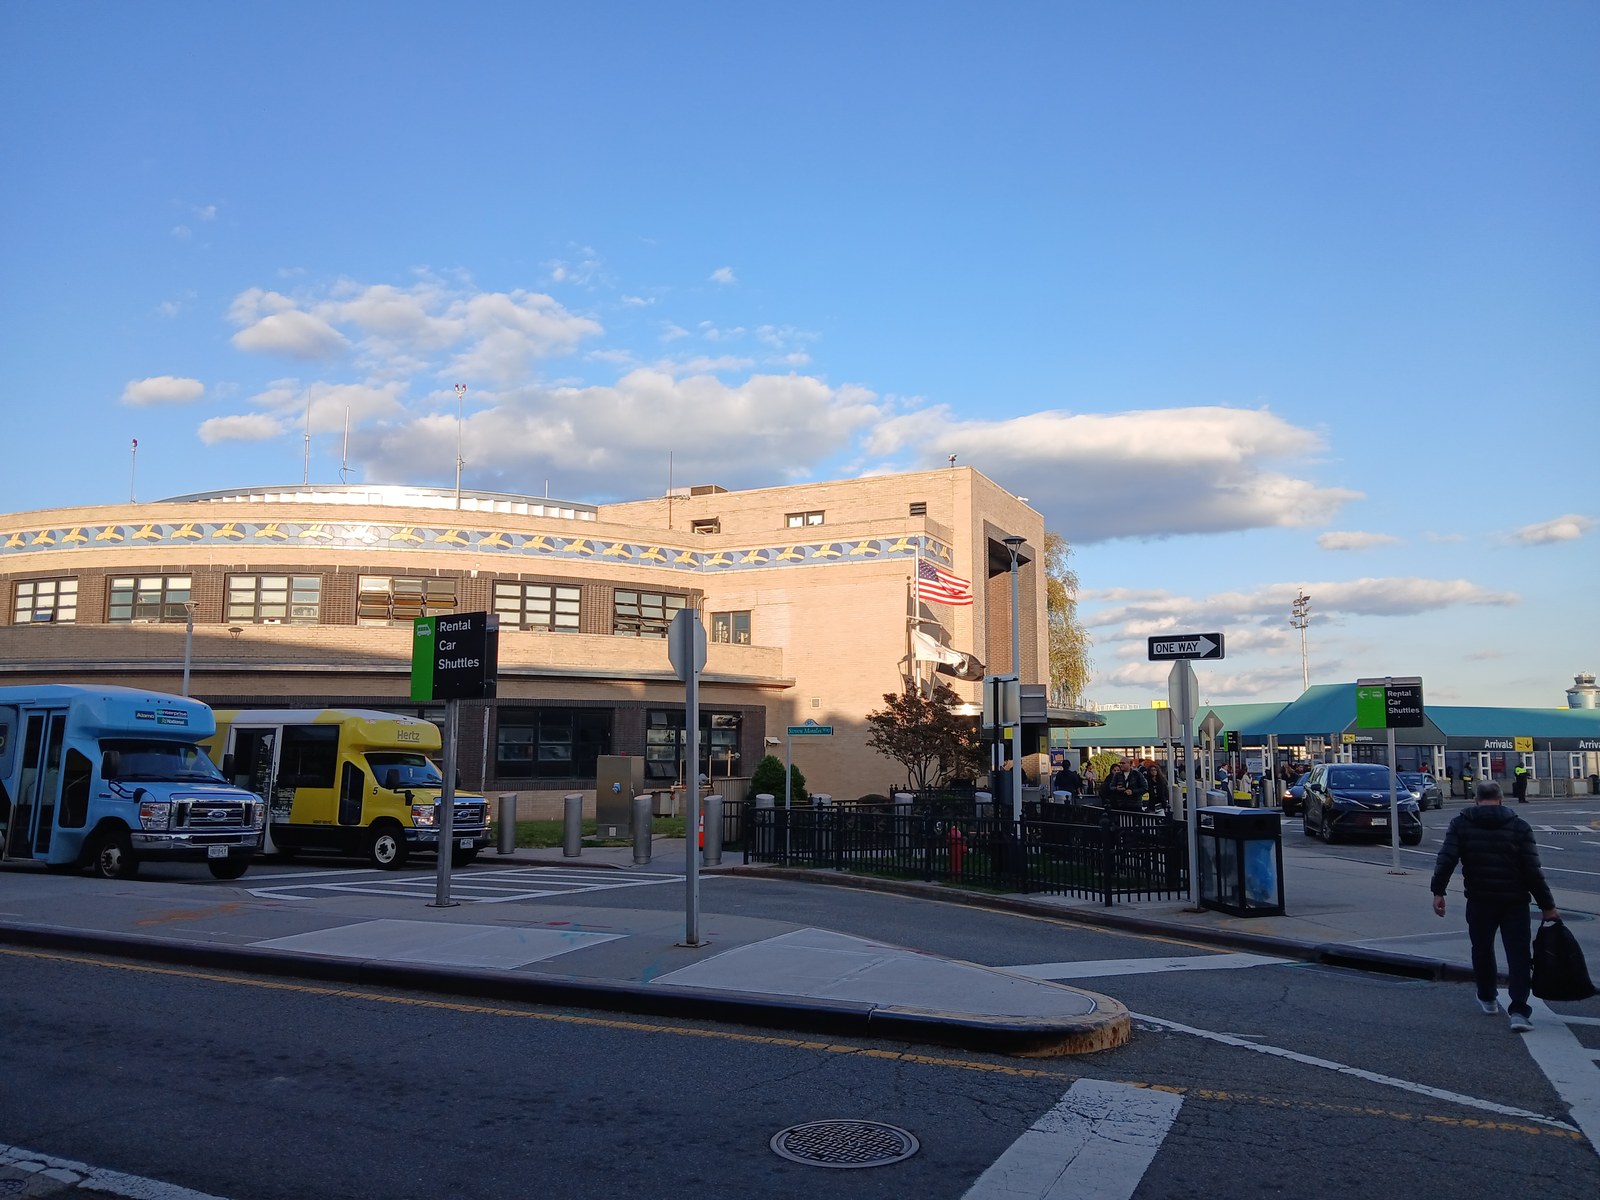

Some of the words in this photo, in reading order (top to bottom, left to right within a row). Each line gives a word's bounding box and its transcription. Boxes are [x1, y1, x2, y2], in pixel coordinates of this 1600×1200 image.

[440, 619, 471, 632] Rental
[439, 640, 457, 651] Car
[1155, 643, 1175, 653] ONE
[1178, 642, 1198, 652] WAY
[438, 657, 480, 670] Shuttles
[1387, 690, 1412, 698] Rental
[397, 730, 420, 741] Hertz
[1484, 739, 1513, 749] Arrivals
[1579, 739, 1600, 749] Arriv
[373, 787, 378, 795] 5
